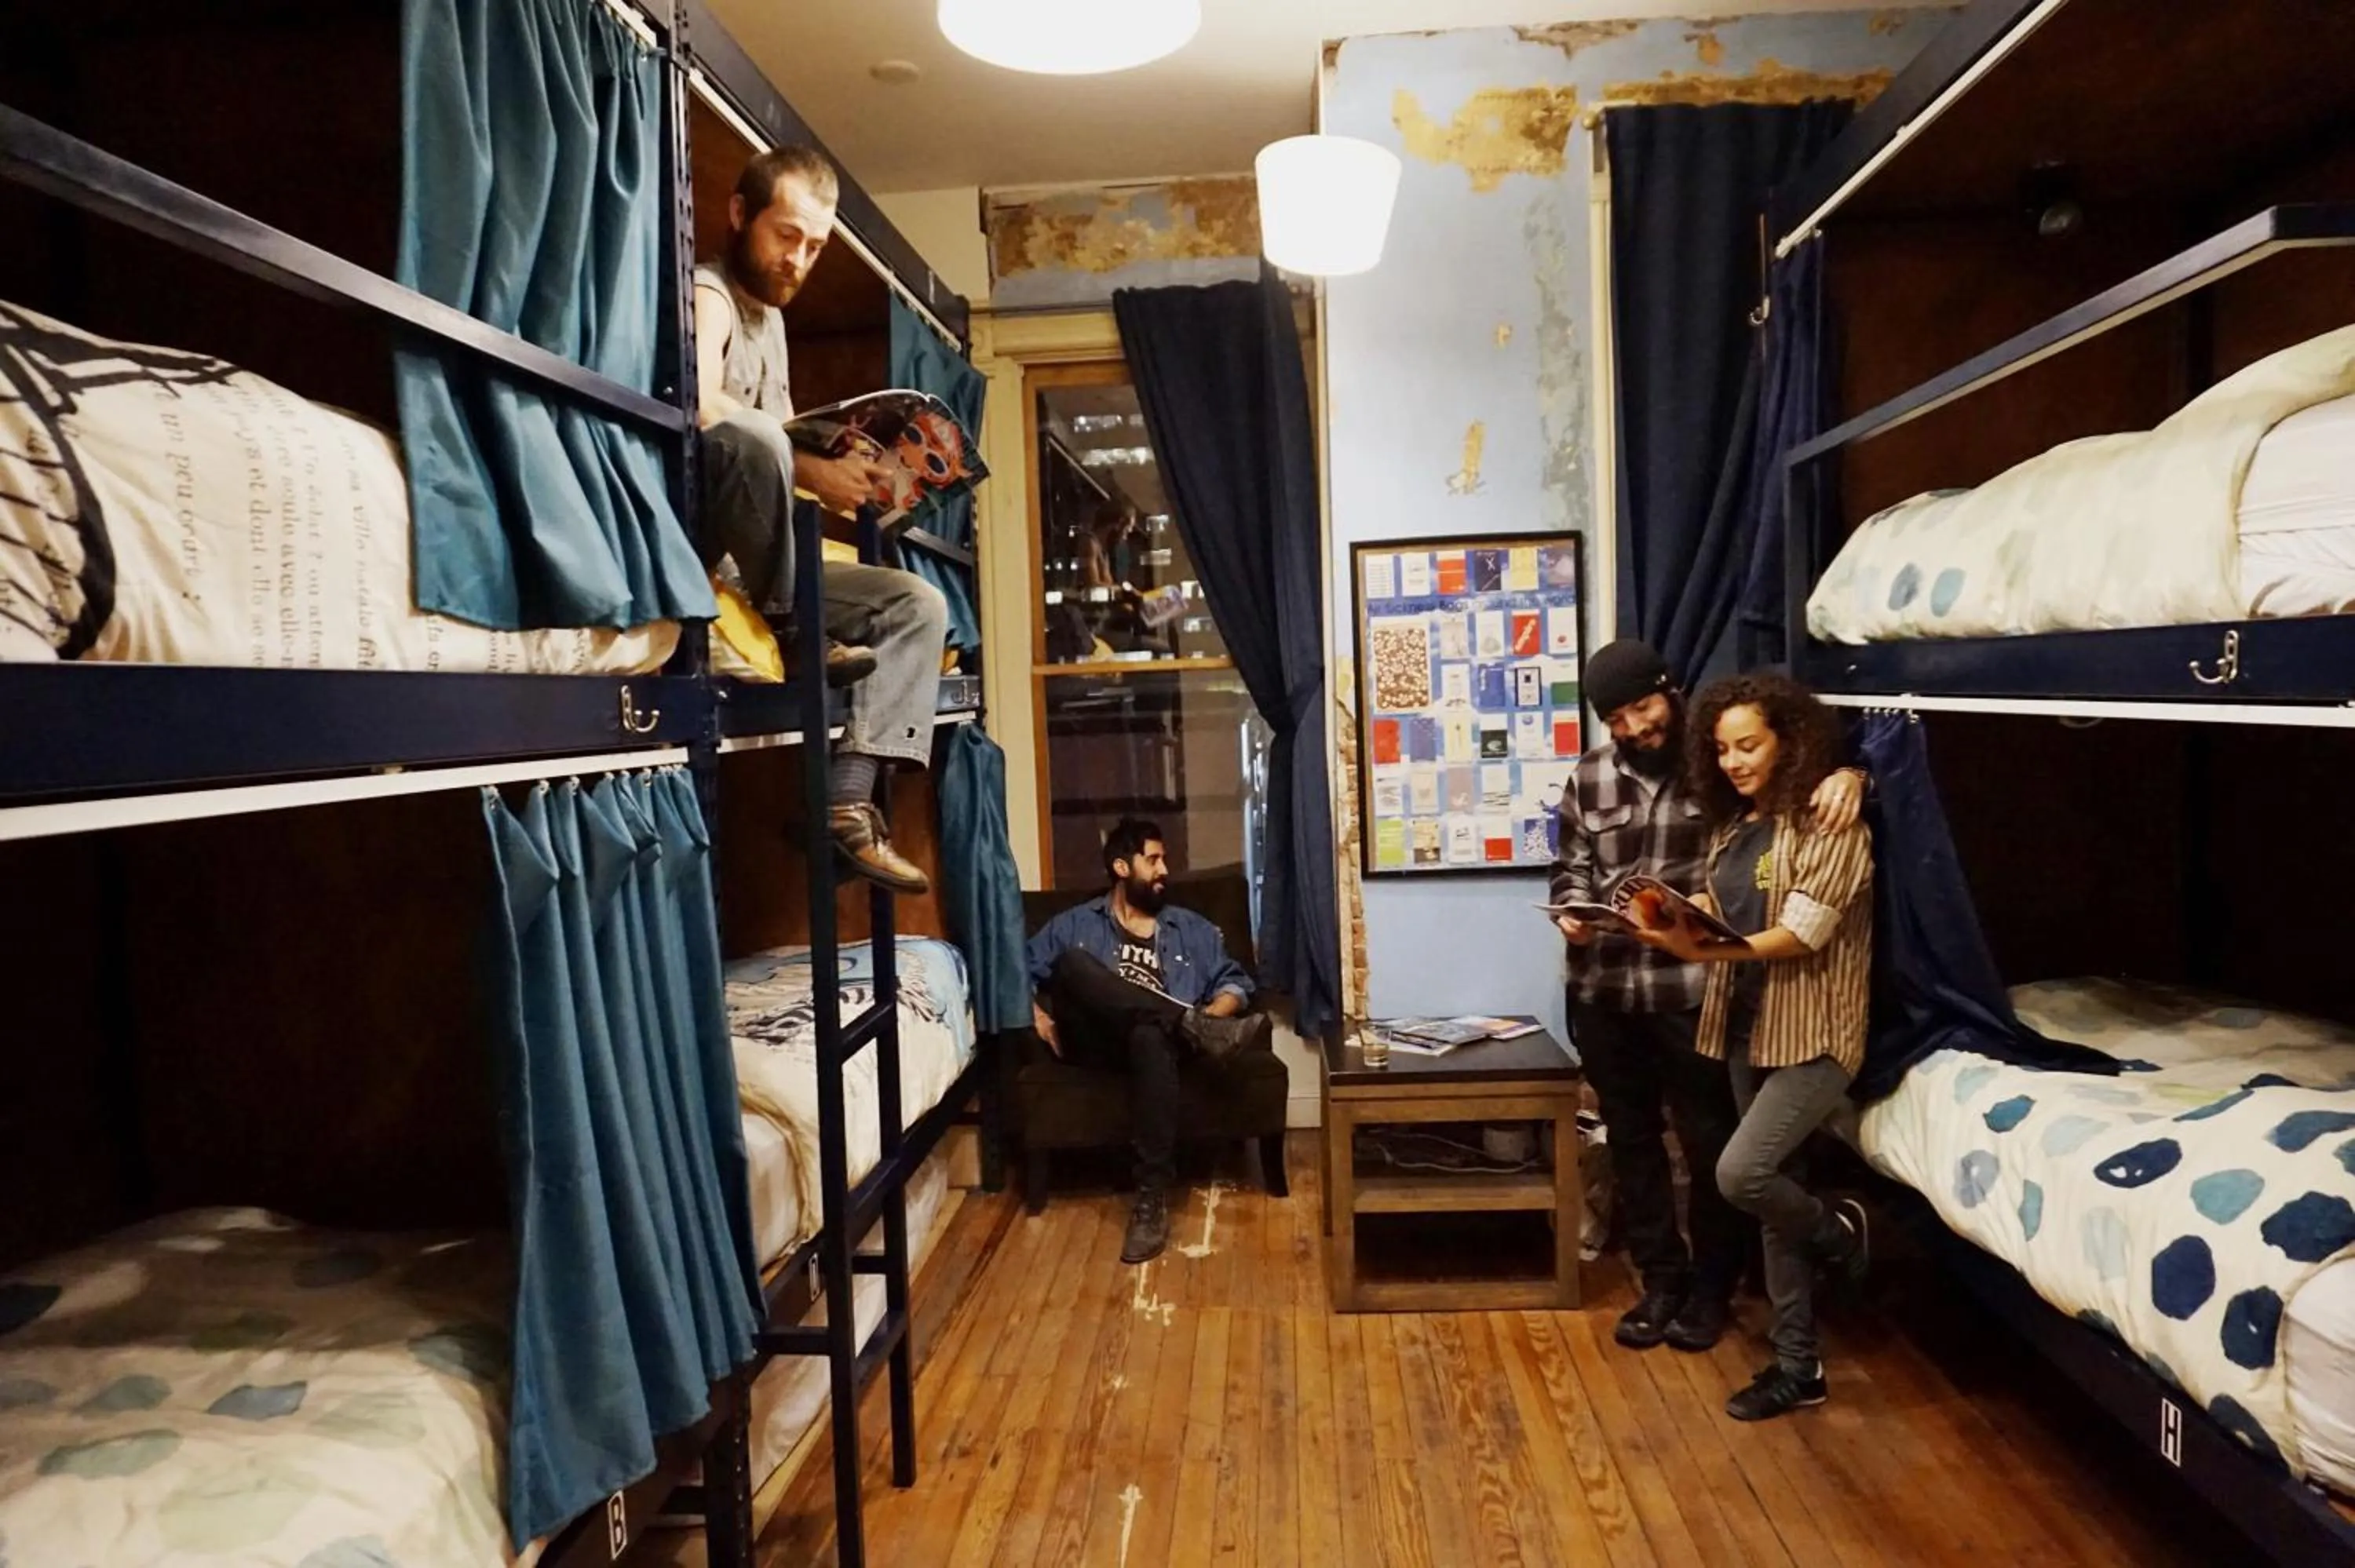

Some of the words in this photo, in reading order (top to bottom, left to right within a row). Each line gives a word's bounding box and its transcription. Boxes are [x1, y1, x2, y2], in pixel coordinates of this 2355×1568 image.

[164, 451, 195, 499] peu
[249, 468, 268, 490] et
[249, 500, 272, 553] dont
[279, 544, 298, 596] avec
[2163, 1399, 2180, 1466] H
